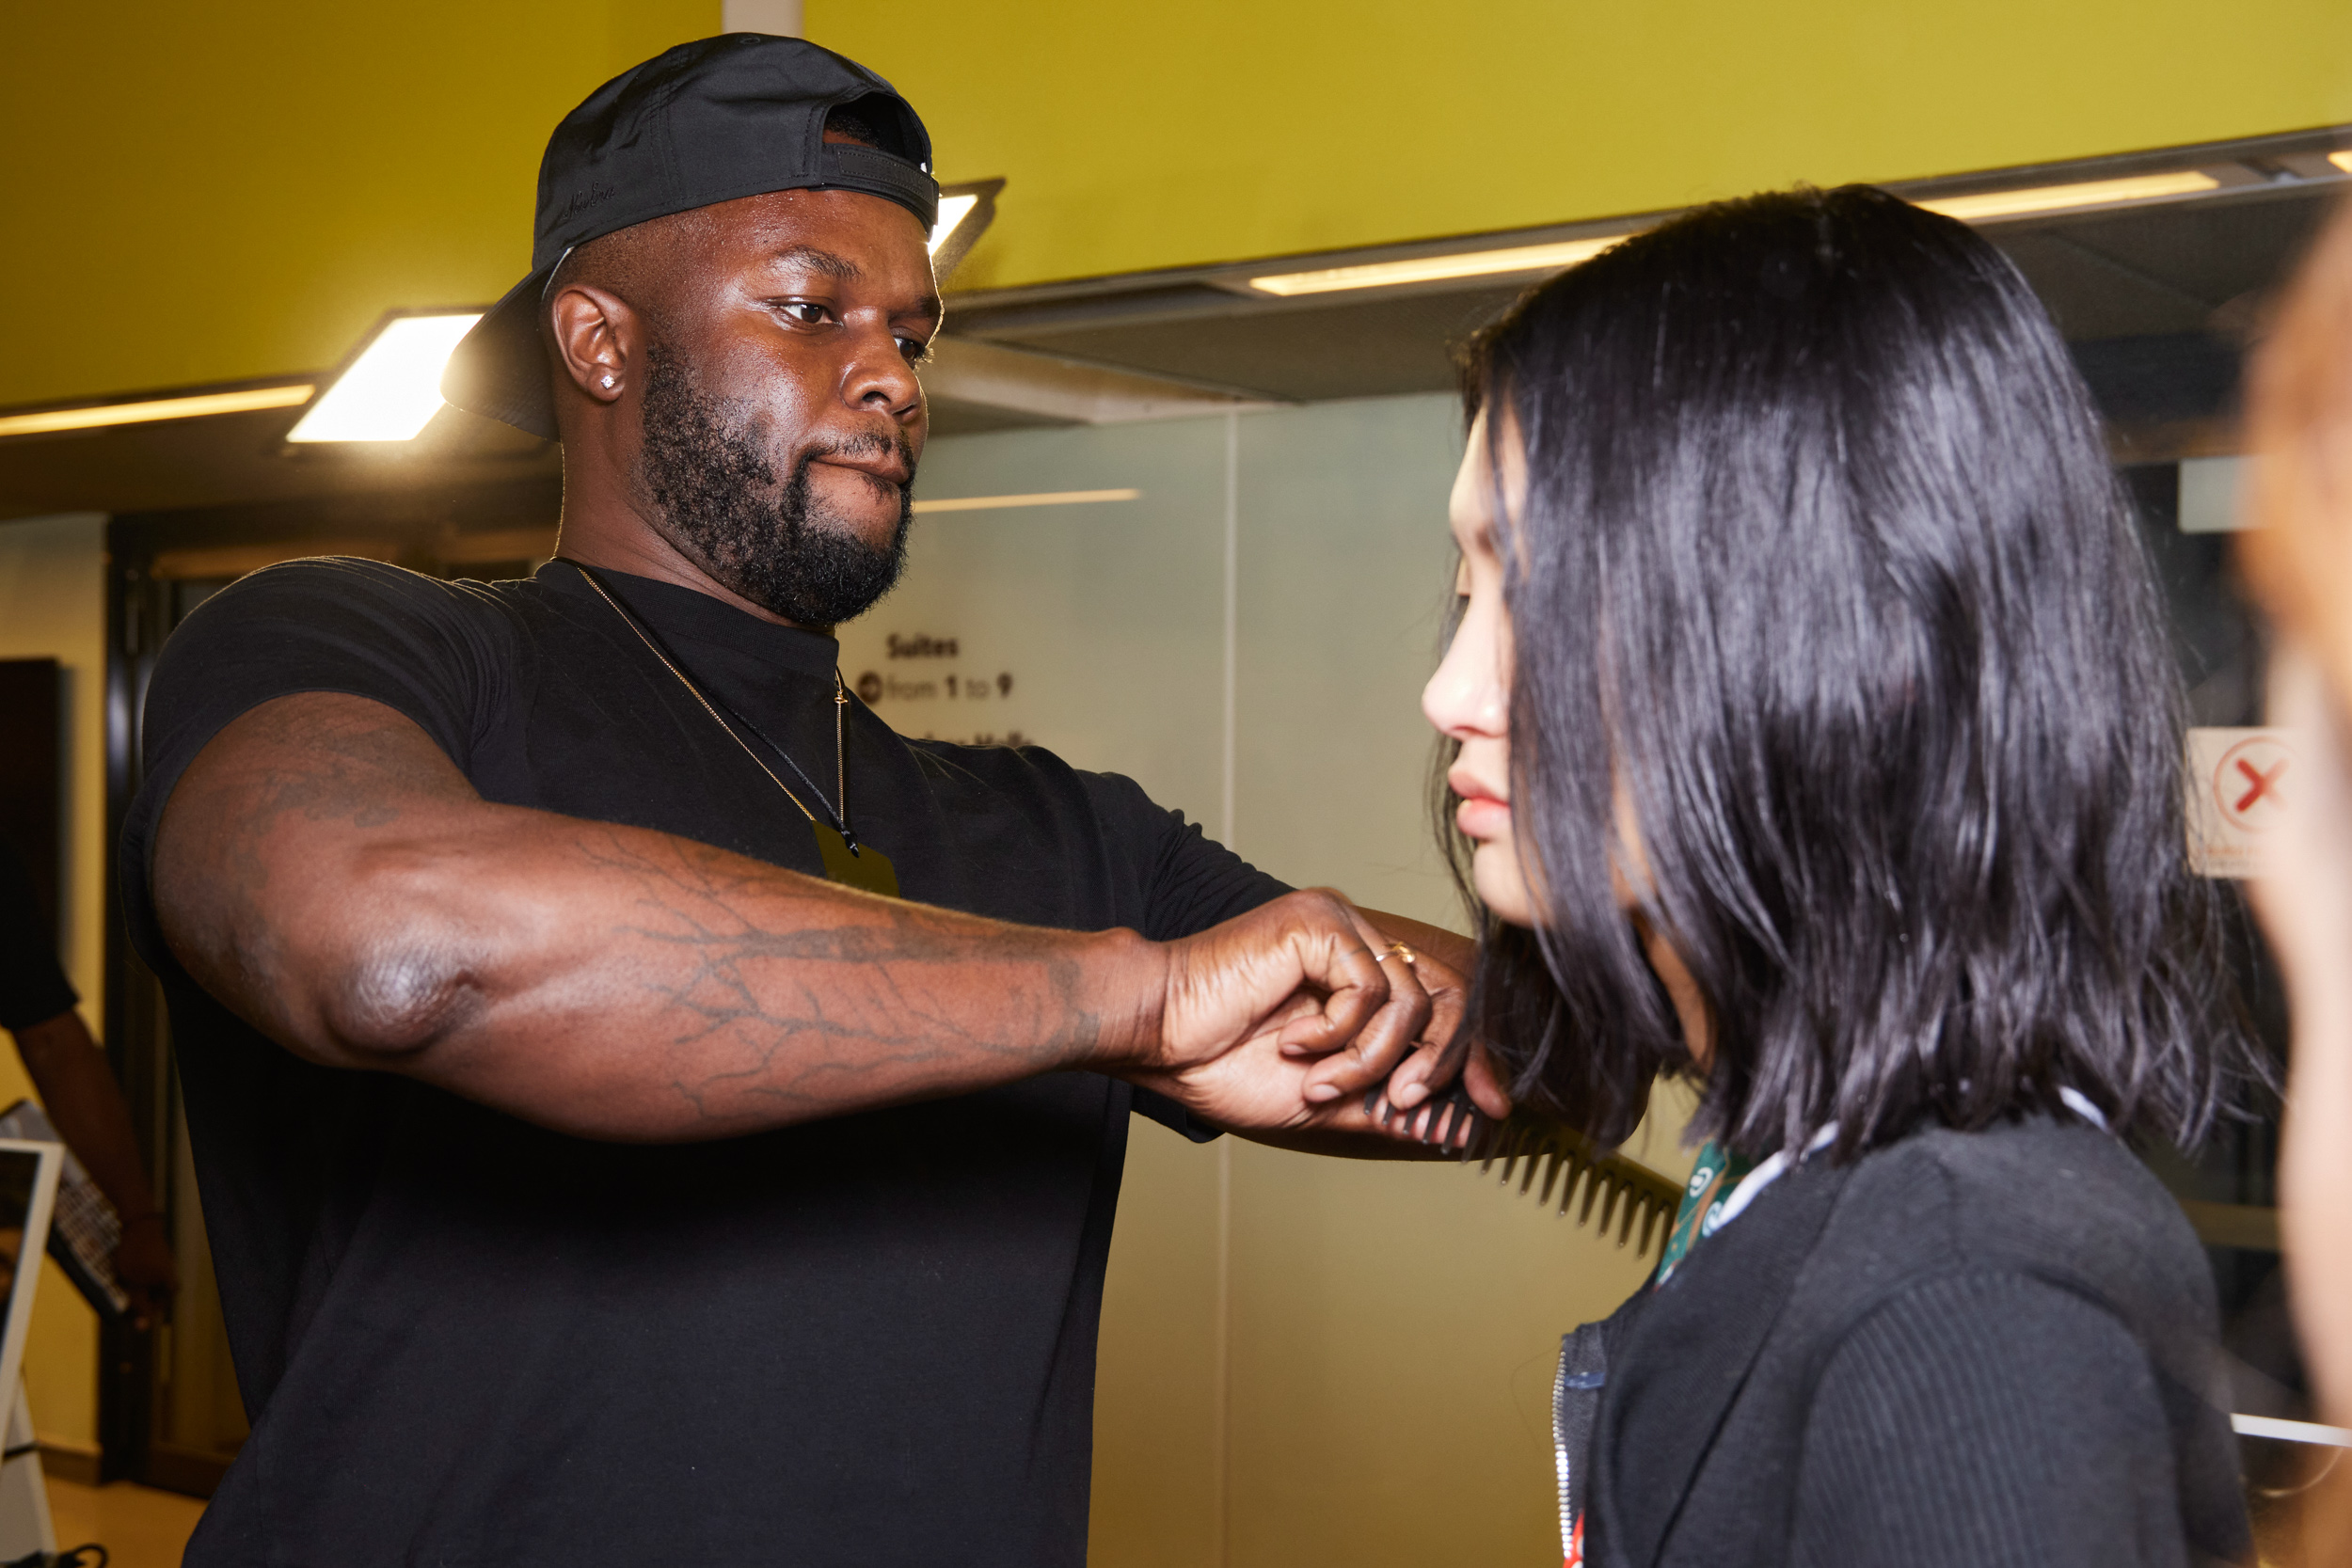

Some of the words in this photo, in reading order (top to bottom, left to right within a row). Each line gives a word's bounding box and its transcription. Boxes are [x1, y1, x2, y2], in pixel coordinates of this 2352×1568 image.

[887, 634, 959, 659] Suites
[885, 673, 937, 699] from
[946, 673, 958, 698] 1
[965, 676, 990, 699] to
[996, 672, 1014, 698] 9
